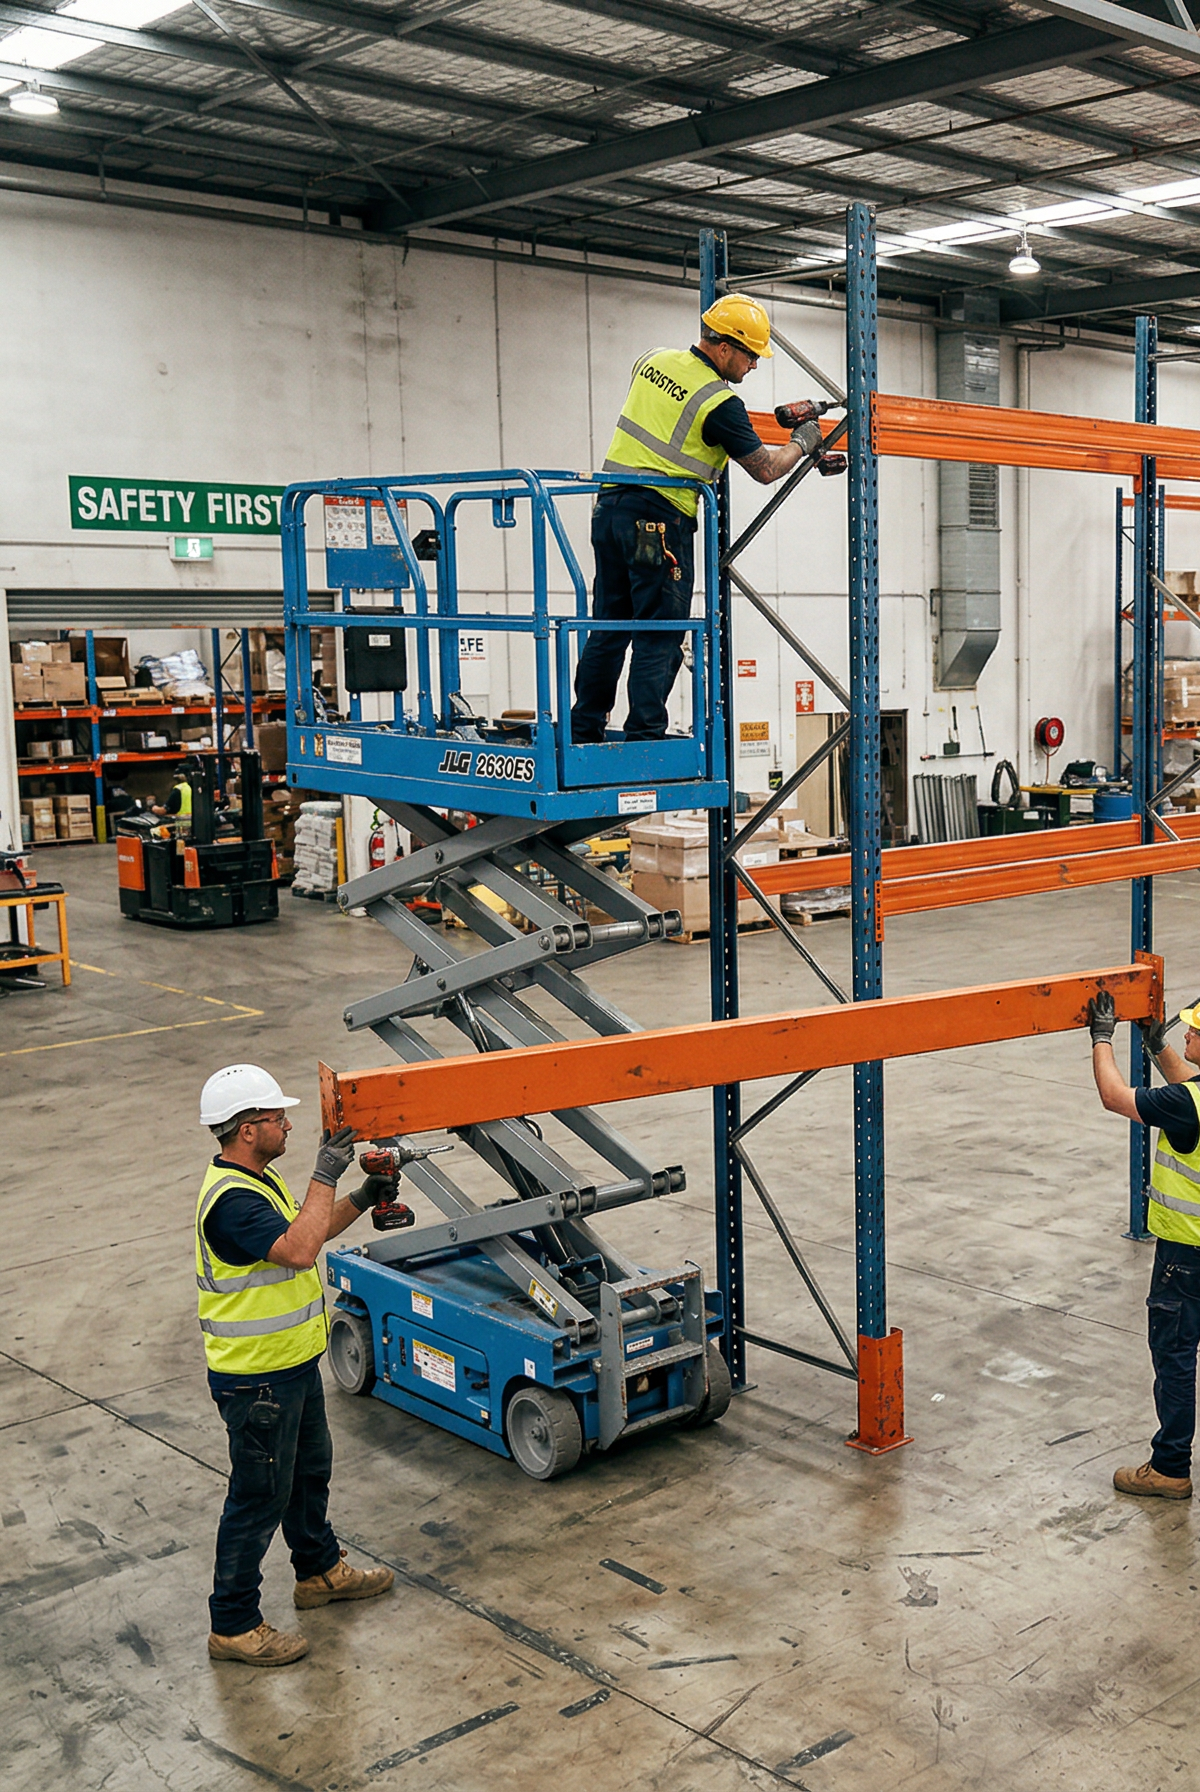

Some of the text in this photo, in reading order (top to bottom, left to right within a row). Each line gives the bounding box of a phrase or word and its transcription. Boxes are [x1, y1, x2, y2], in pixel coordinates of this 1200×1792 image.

[640, 363, 688, 402] LOGISTICS
[77, 485, 282, 526] SAFETY FIRST
[438, 750, 536, 783] JLG 2630ES
